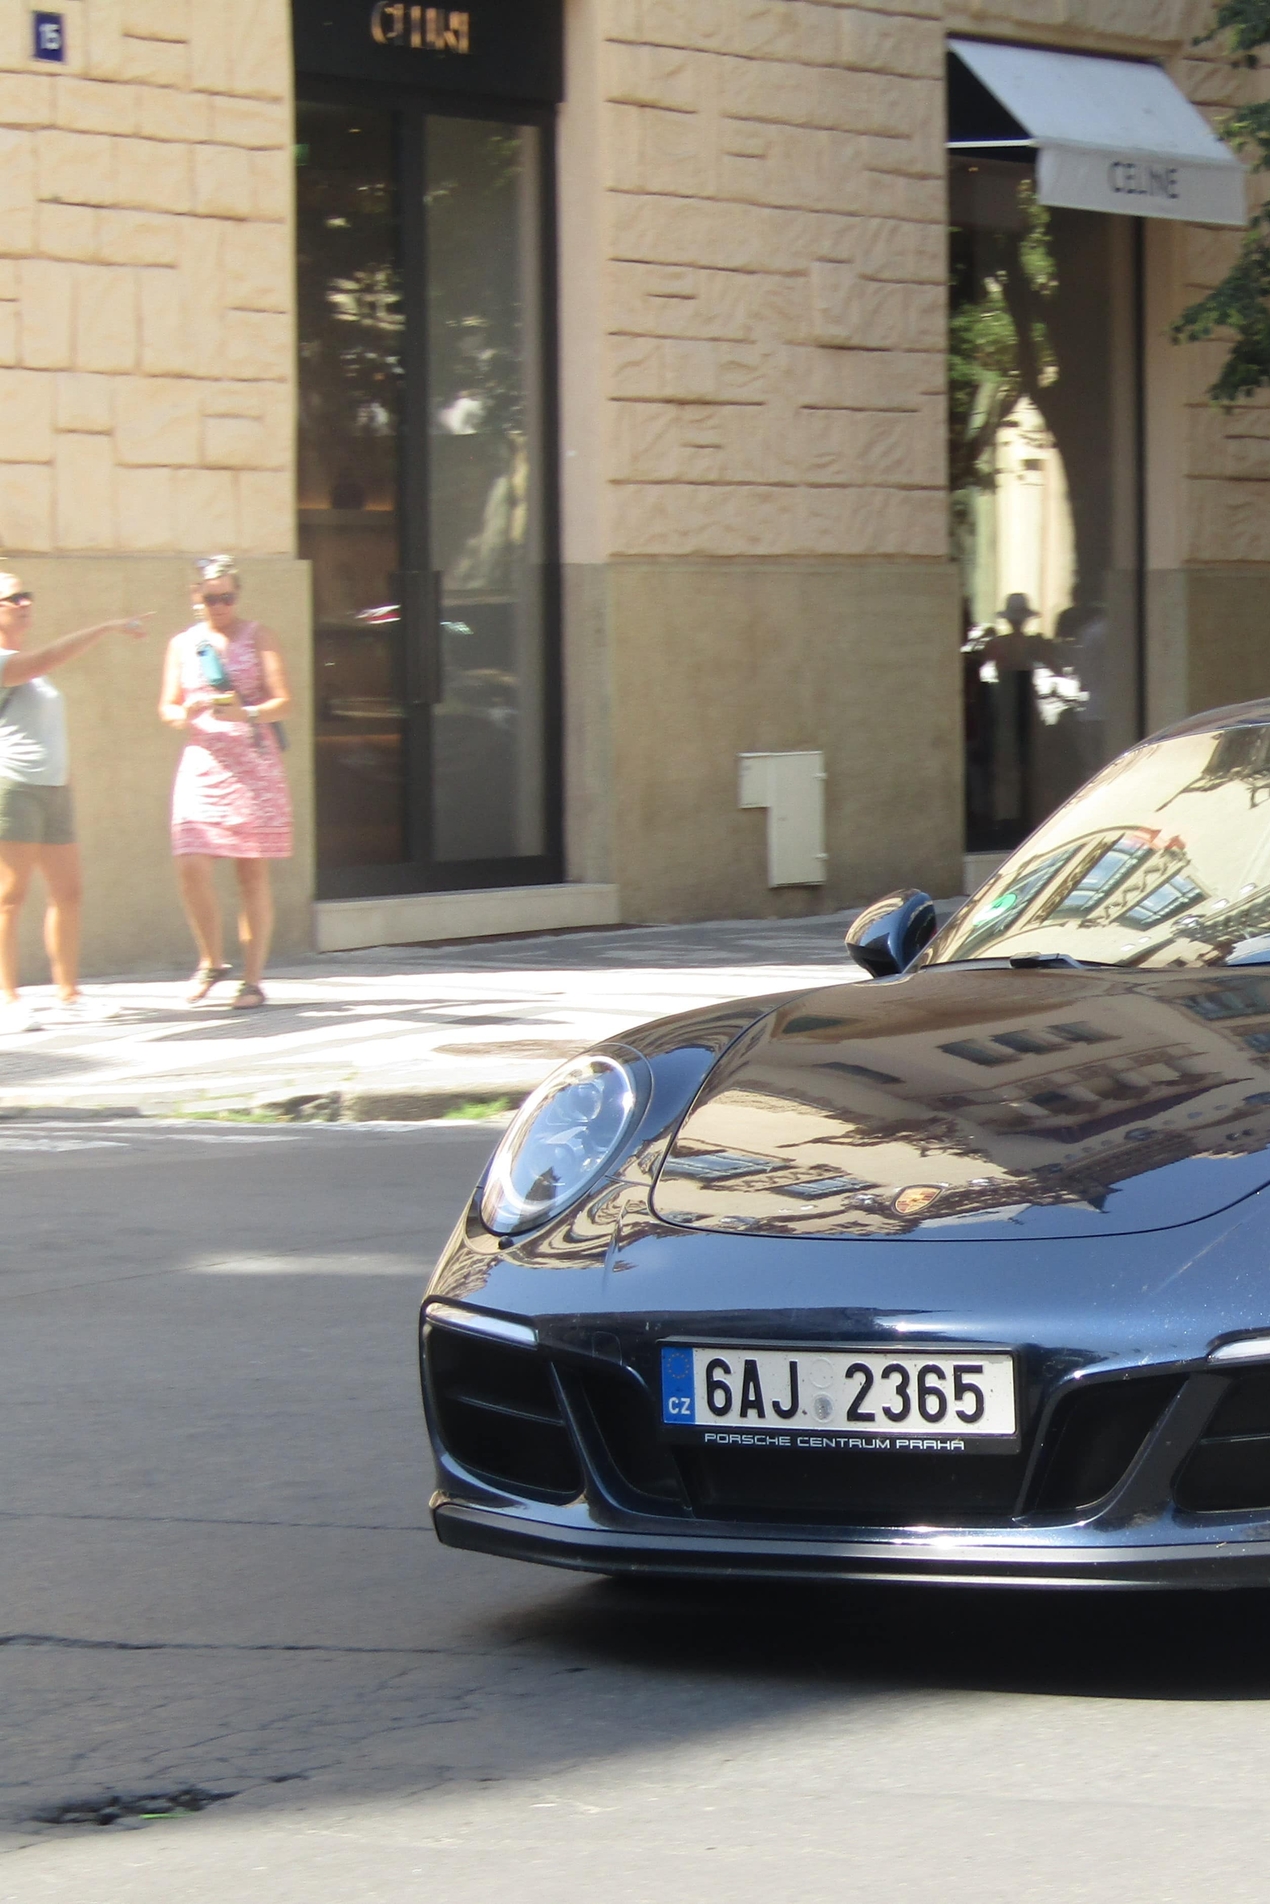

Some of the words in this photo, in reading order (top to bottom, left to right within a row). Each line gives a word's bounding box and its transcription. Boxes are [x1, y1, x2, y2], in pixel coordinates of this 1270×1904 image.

[39, 23, 61, 50] 15
[1107, 162, 1179, 199] CELINE
[705, 1357, 800, 1420] 6AJ
[845, 1362, 985, 1423] 2365
[668, 1396, 691, 1415] CZ
[704, 1433, 791, 1446] PORSCHE
[797, 1436, 890, 1449] CENTRUM
[896, 1439, 965, 1450] PRAHA
